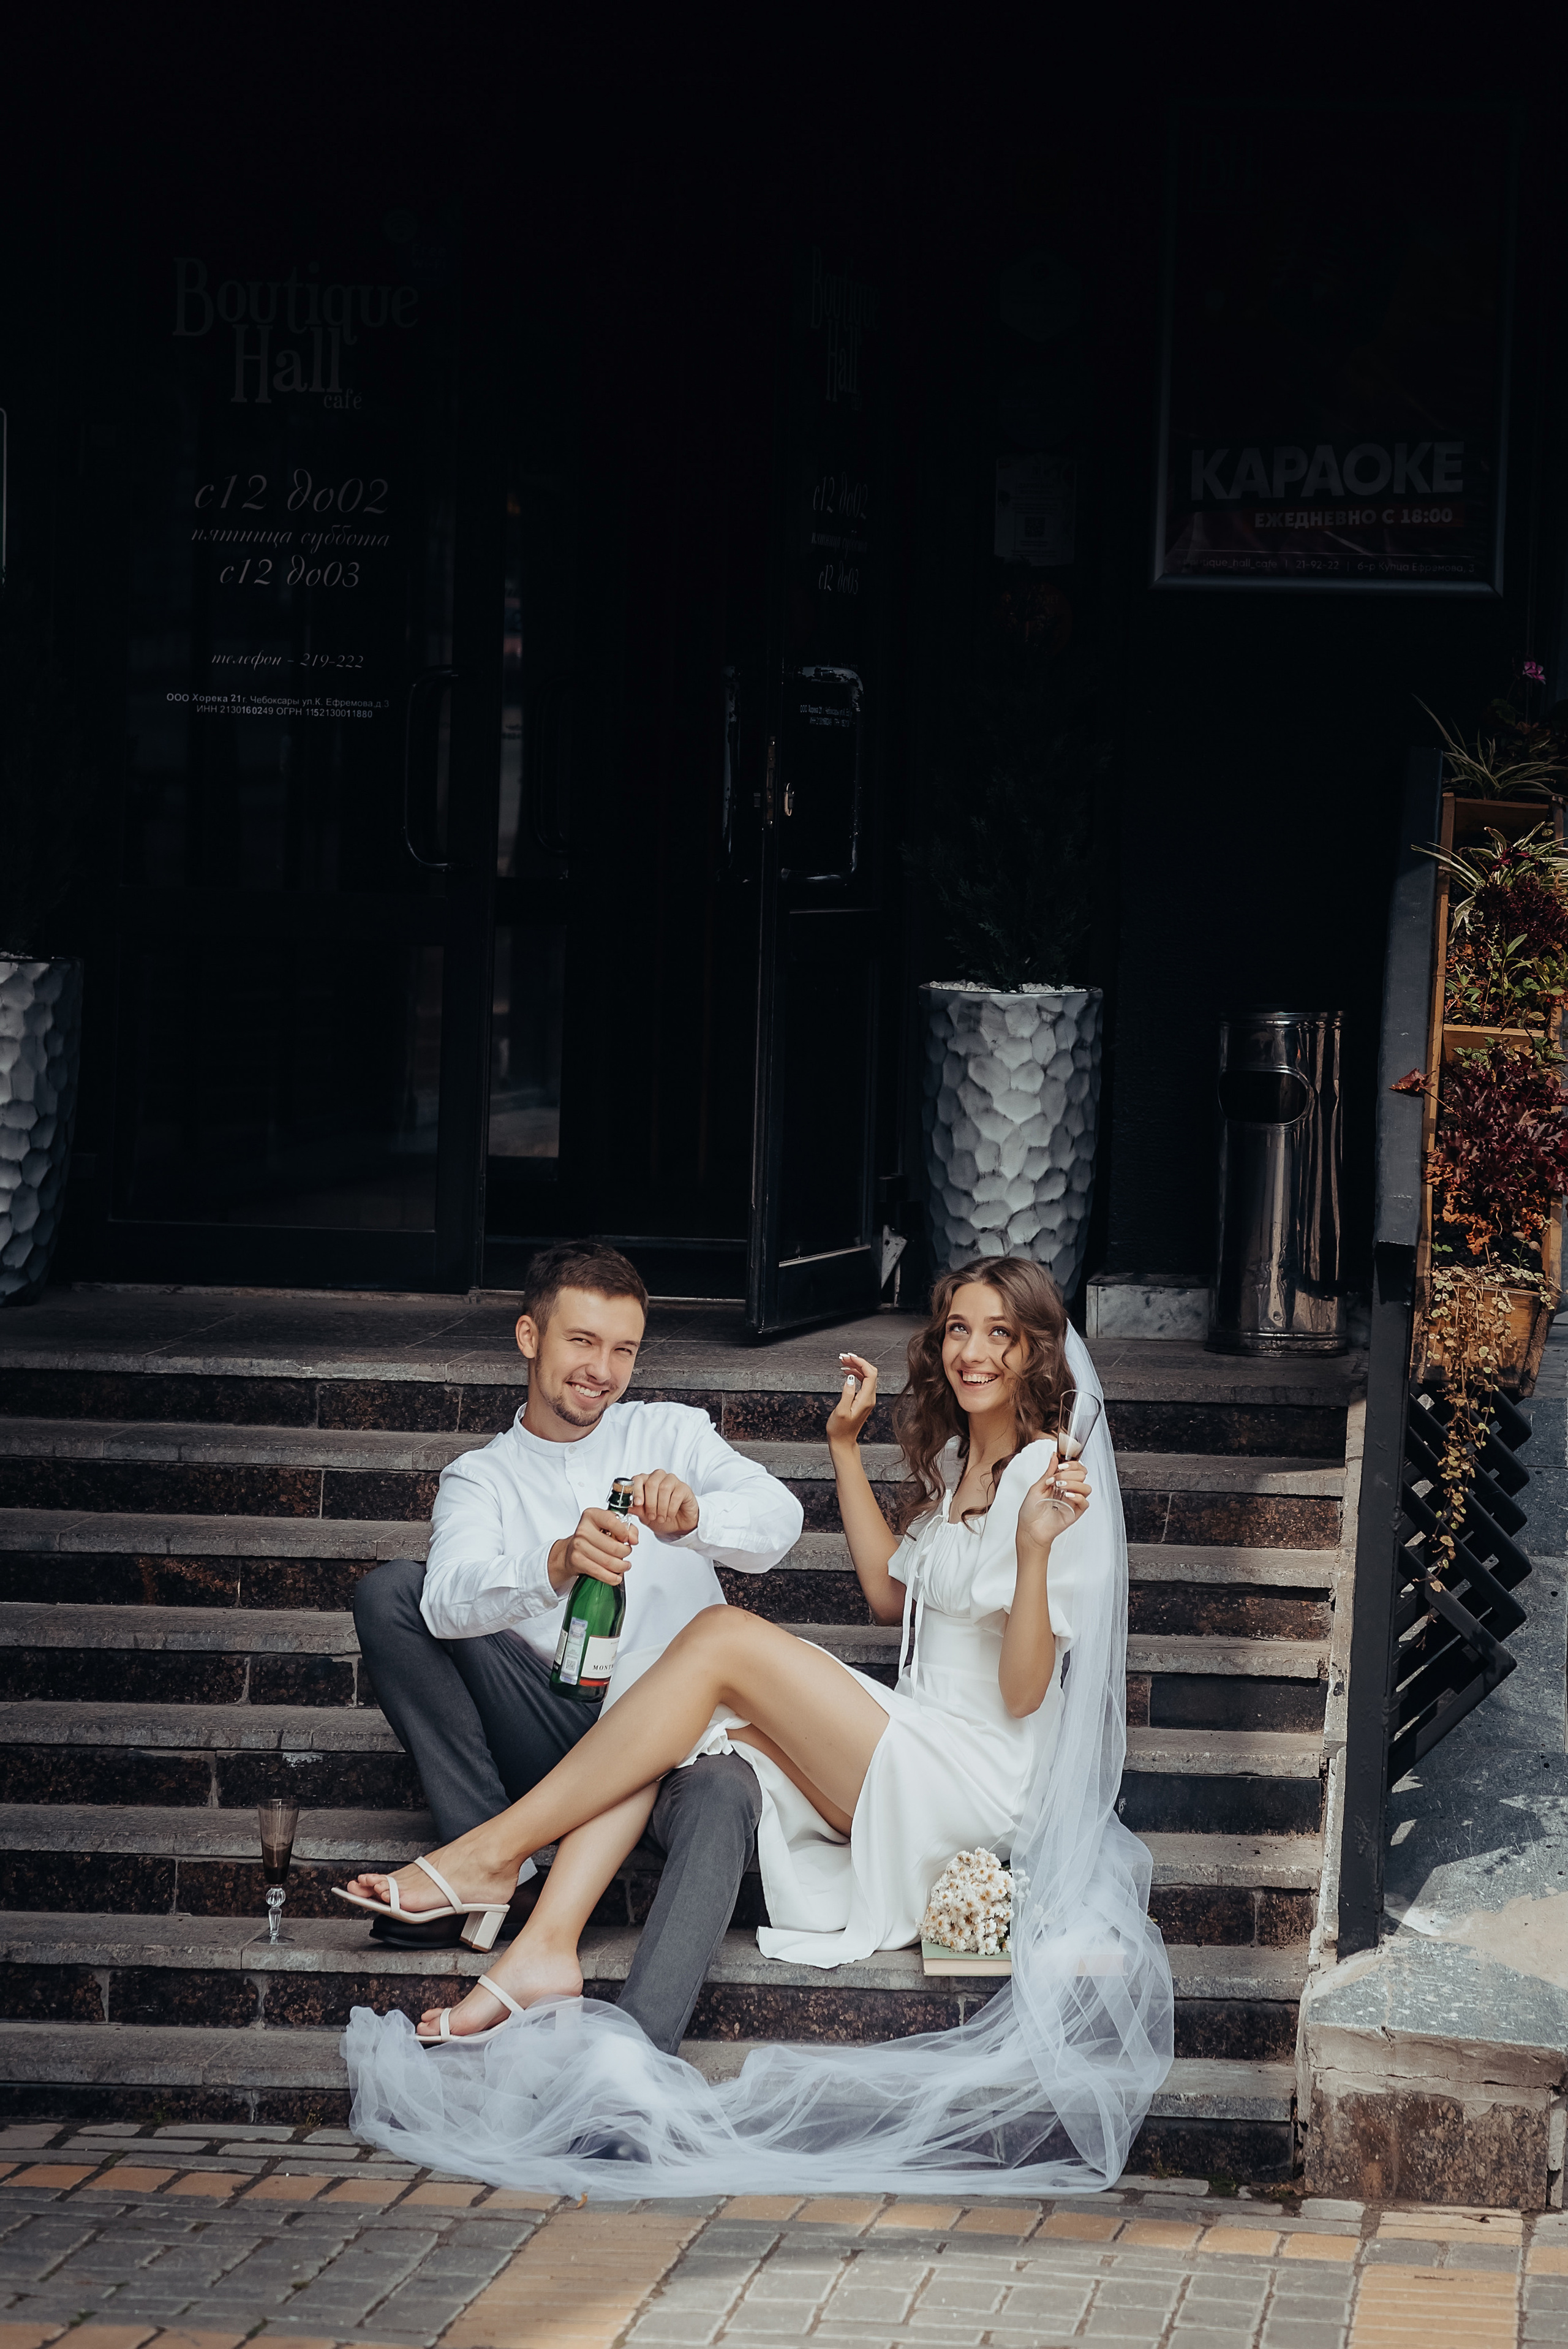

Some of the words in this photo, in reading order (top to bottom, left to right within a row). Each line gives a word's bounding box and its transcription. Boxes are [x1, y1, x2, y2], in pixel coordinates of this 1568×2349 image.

[410, 243, 447, 257] Free
[172, 257, 419, 345] Boutique
[810, 245, 881, 346] Boutique
[230, 323, 344, 404] Hall
[824, 317, 859, 402] Hall
[323, 388, 363, 410] café
[1190, 441, 1464, 502] КАРАОКЕ
[193, 473, 270, 512] с12
[286, 468, 390, 515] до02
[1254, 510, 1377, 529] ЕЖЕДНЕВНО
[1382, 510, 1395, 524] С
[1400, 507, 1453, 524] 18:00
[190, 528, 293, 549] пятница
[300, 525, 391, 554] суббота
[219, 557, 275, 586] с12
[287, 554, 361, 588] до03
[1295, 559, 1340, 570] 21-92-22
[1378, 561, 1409, 573] Купца
[1468, 564, 1475, 573] 3
[211, 649, 282, 671] телефон
[300, 652, 364, 669] 219-222
[166, 693, 189, 702] ООО
[192, 693, 228, 703] Хорека
[250, 695, 300, 706] Чебоксары
[196, 705, 217, 713] ИНН
[219, 705, 274, 715] 2130160249
[276, 707, 303, 716] ОГРН
[305, 708, 374, 718] 1152130011880
